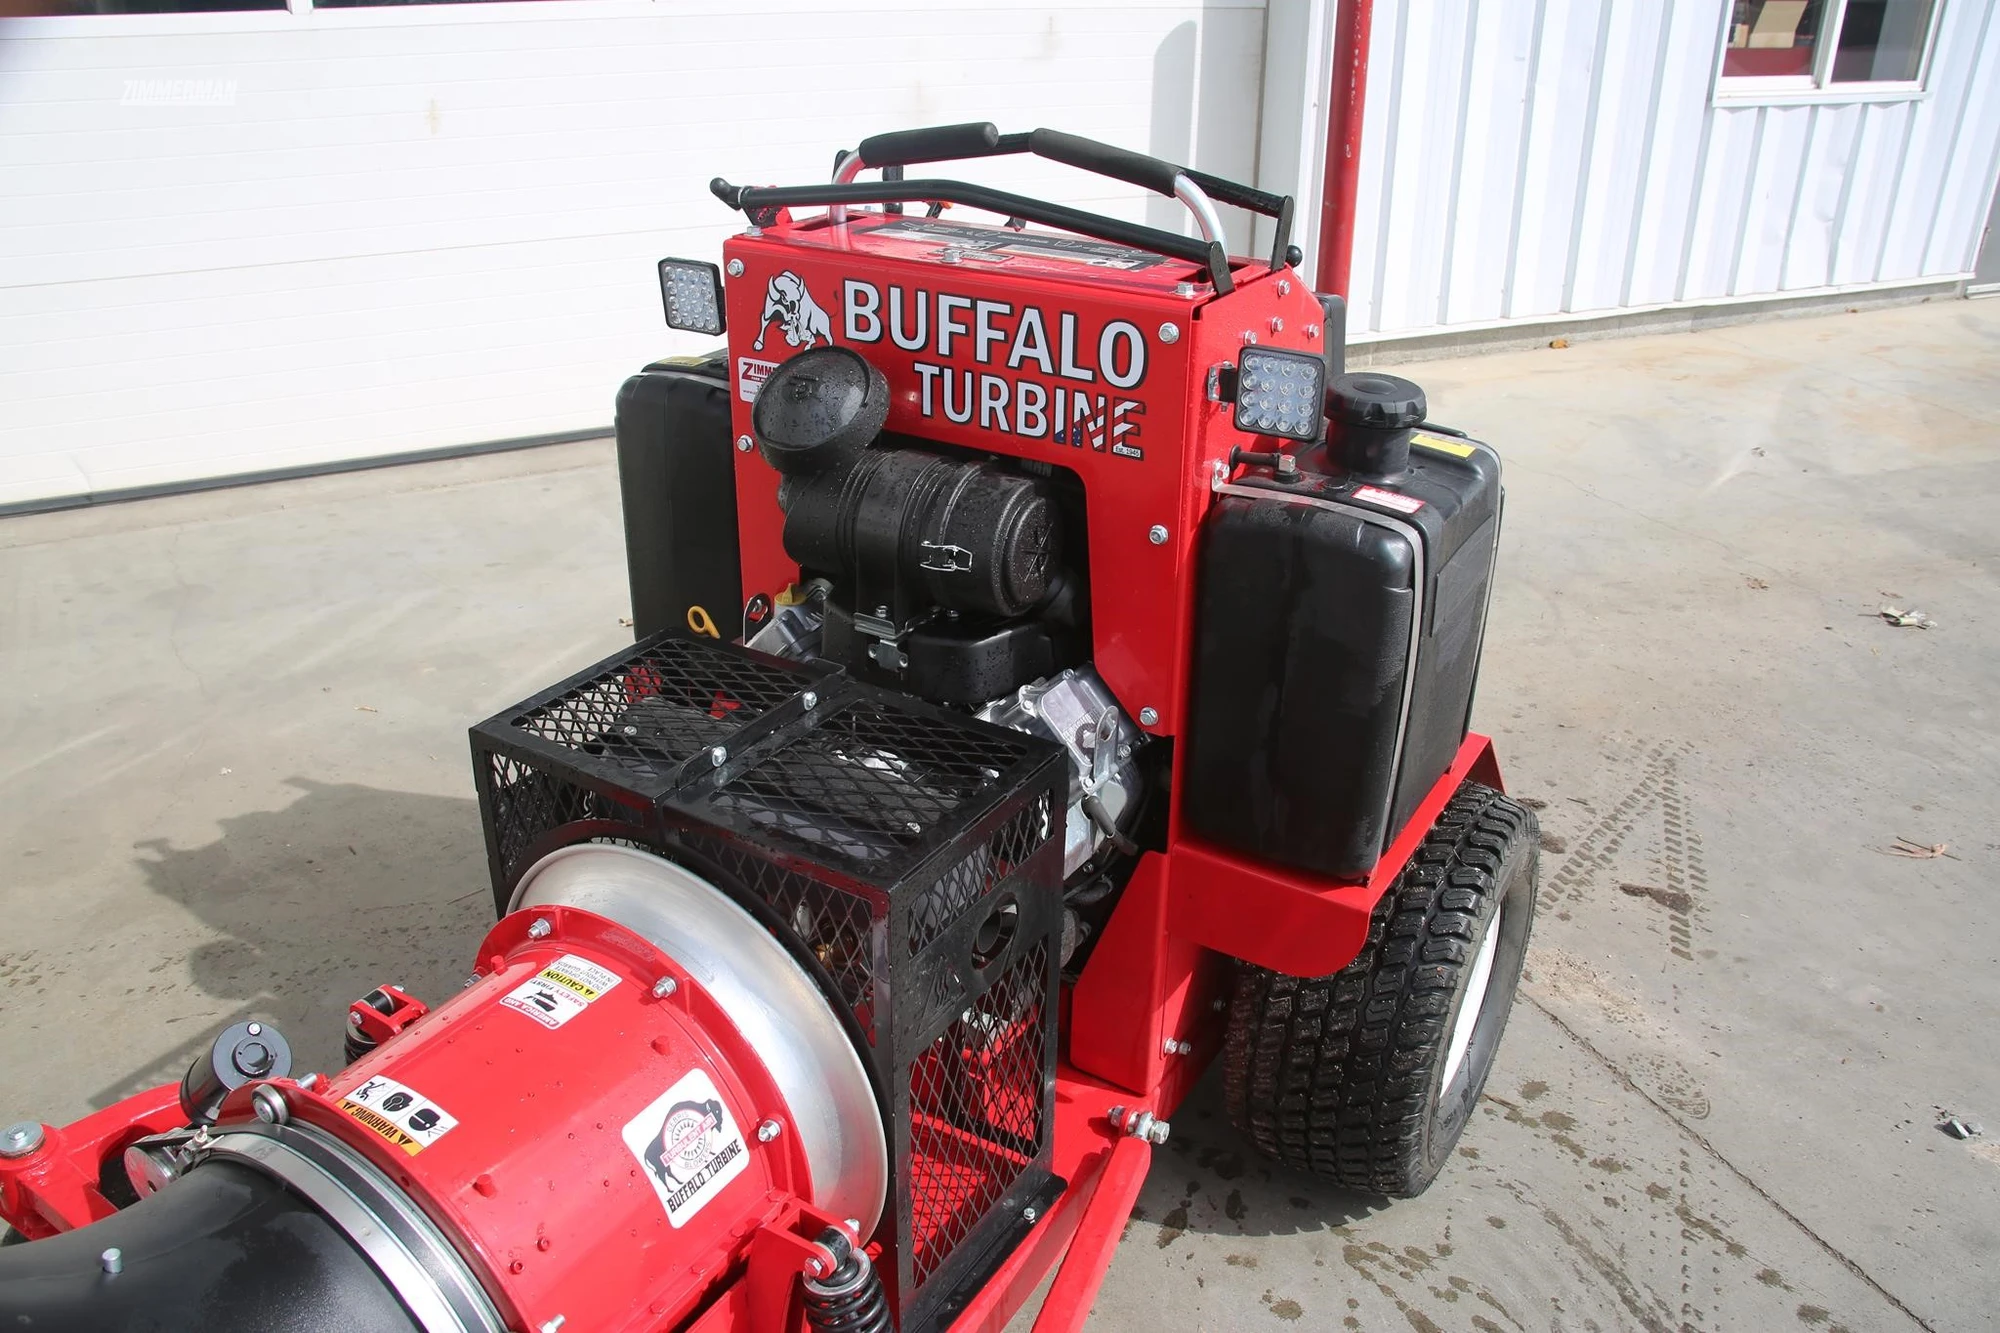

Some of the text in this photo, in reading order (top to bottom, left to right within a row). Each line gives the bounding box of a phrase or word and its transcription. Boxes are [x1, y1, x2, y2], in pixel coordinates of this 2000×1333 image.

[843, 278, 1148, 389] BUFFALO
[742, 362, 777, 380] ZIMM
[914, 362, 1145, 461] TURBINE
[543, 969, 584, 991] CAUTION
[578, 976, 593, 985] NOT
[591, 983, 603, 991] DO
[553, 988, 584, 1006] SAFETY
[519, 1002, 557, 1025] AMERICA
[351, 1107, 399, 1138] WARNING
[667, 1111, 689, 1132] DEBRIS
[666, 1139, 742, 1213] BUFFALO TURBINE
